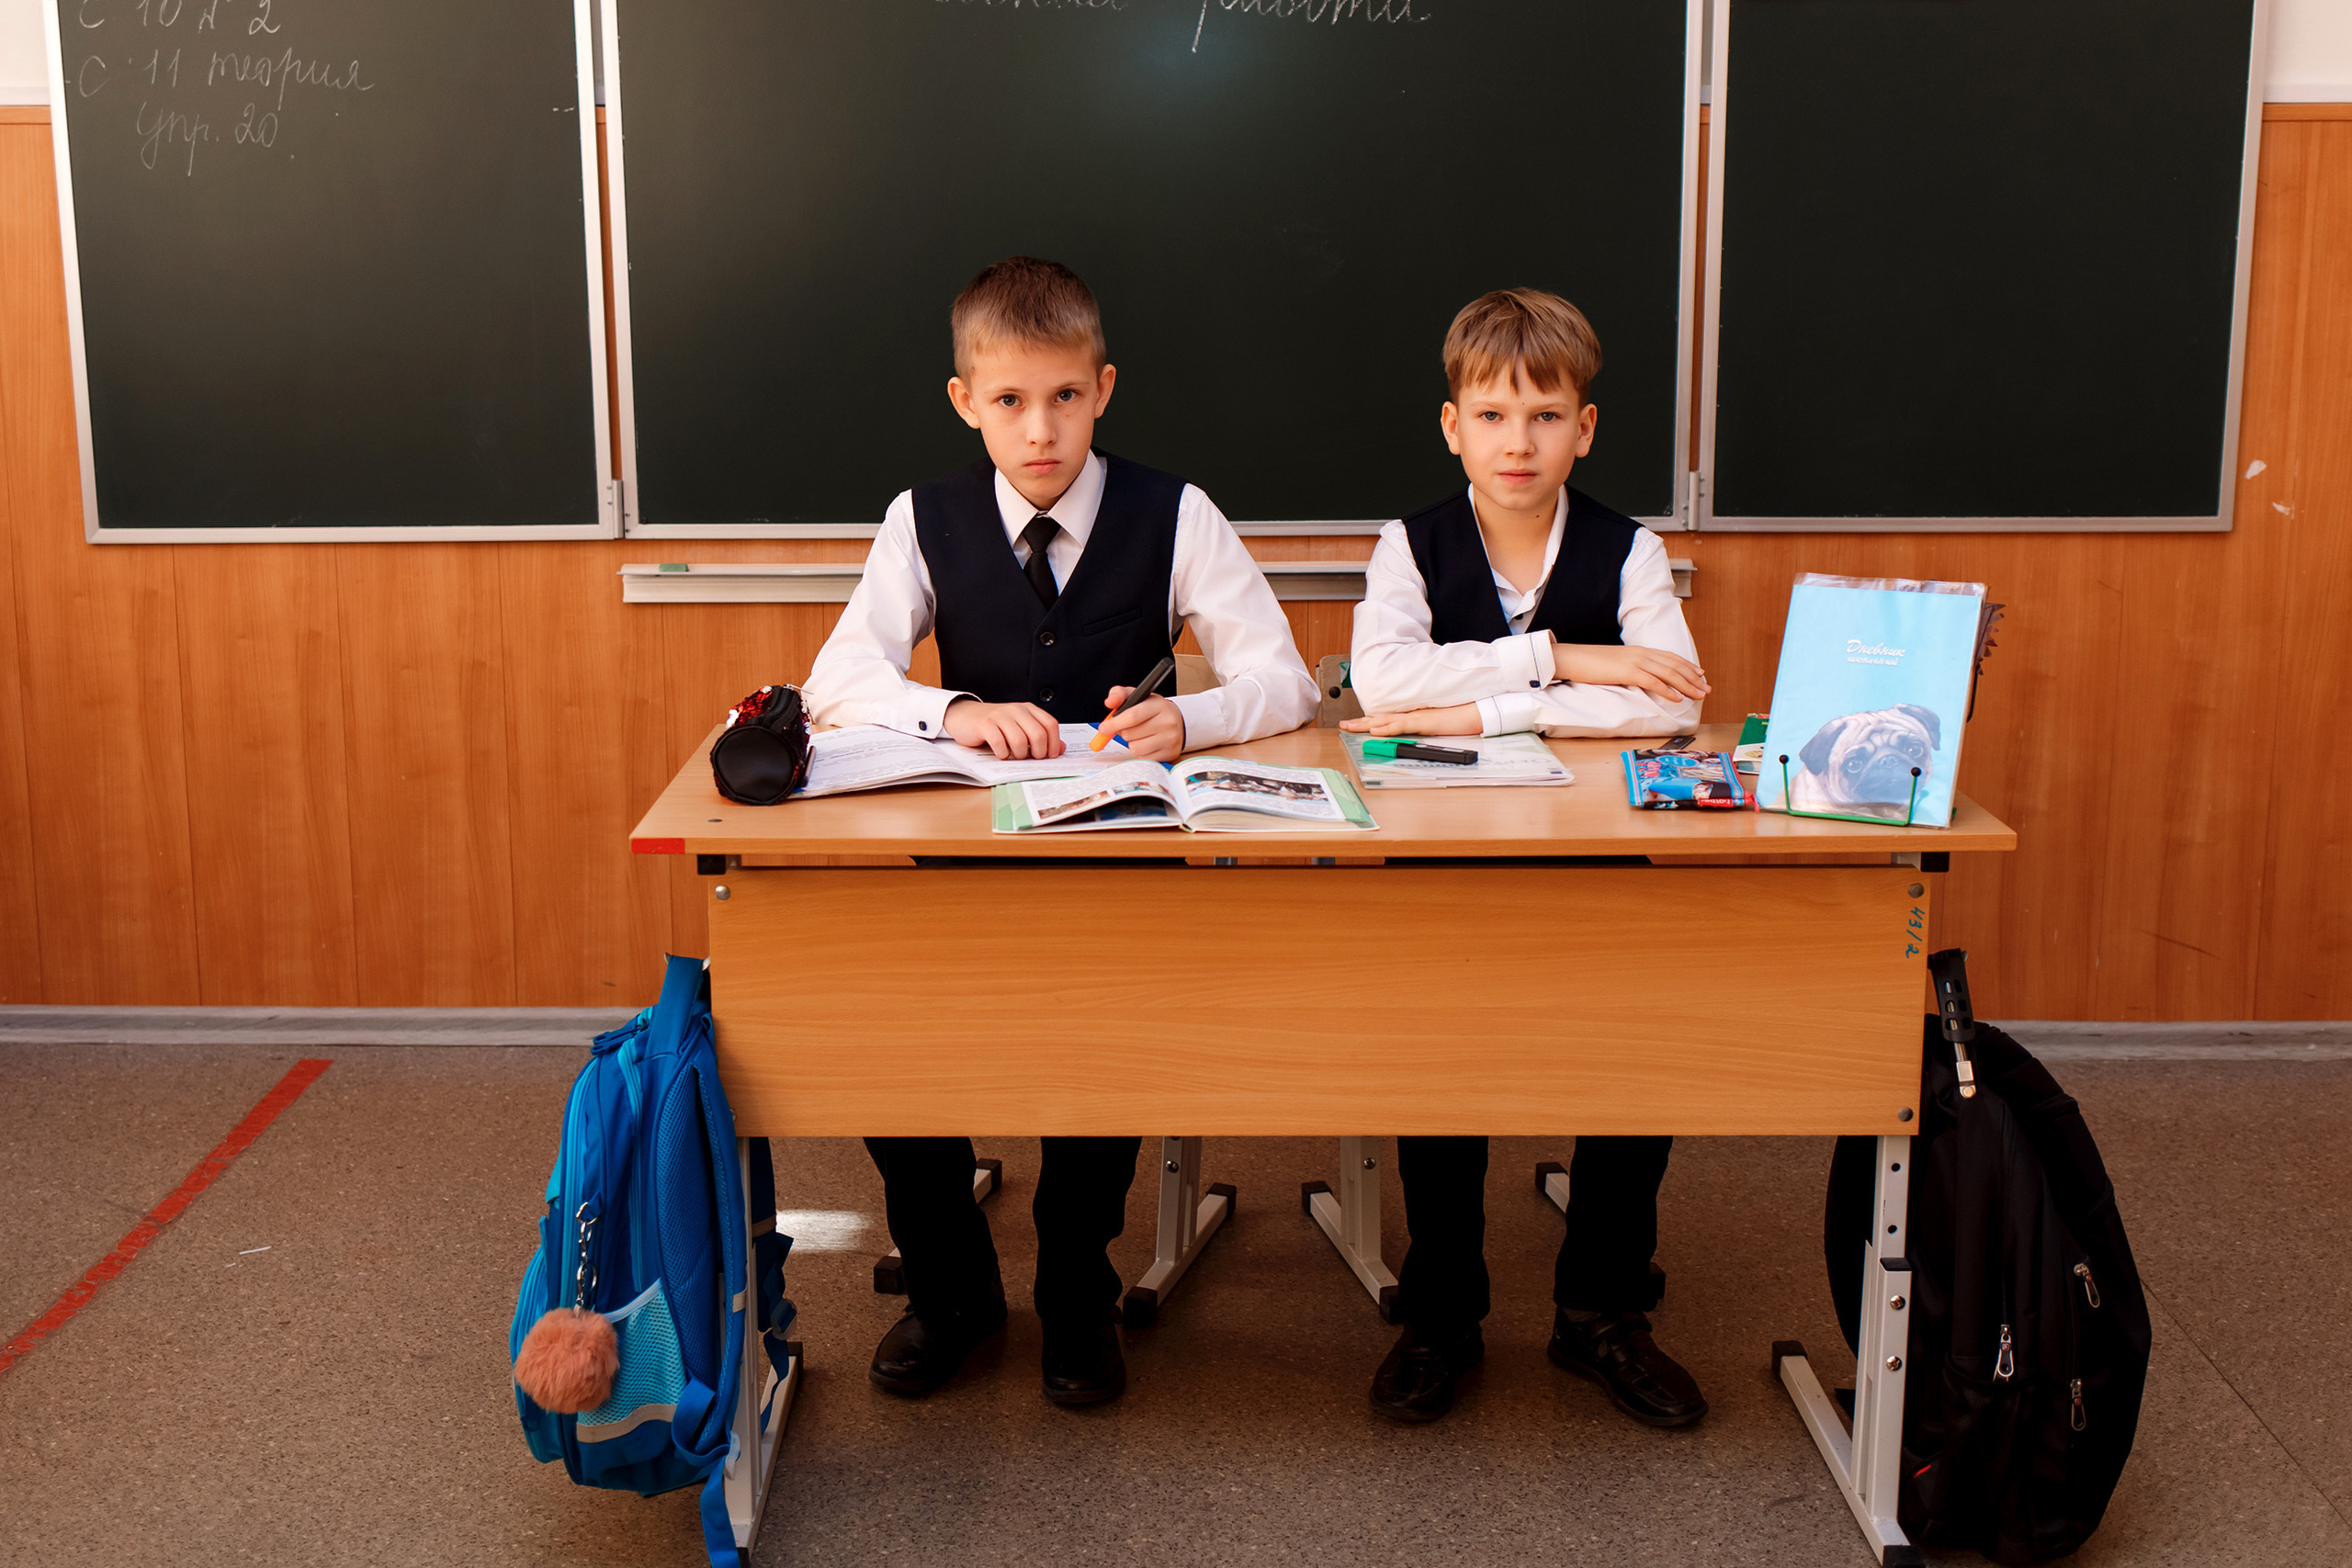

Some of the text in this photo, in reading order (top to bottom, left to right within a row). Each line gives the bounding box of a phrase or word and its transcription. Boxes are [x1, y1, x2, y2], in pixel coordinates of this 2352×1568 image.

[248, 0, 282, 36] 2
[141, 48, 182, 88] 11
[207, 47, 375, 111] теория
[234, 102, 278, 148] 20
[1847, 638, 1906, 658] Дневник
